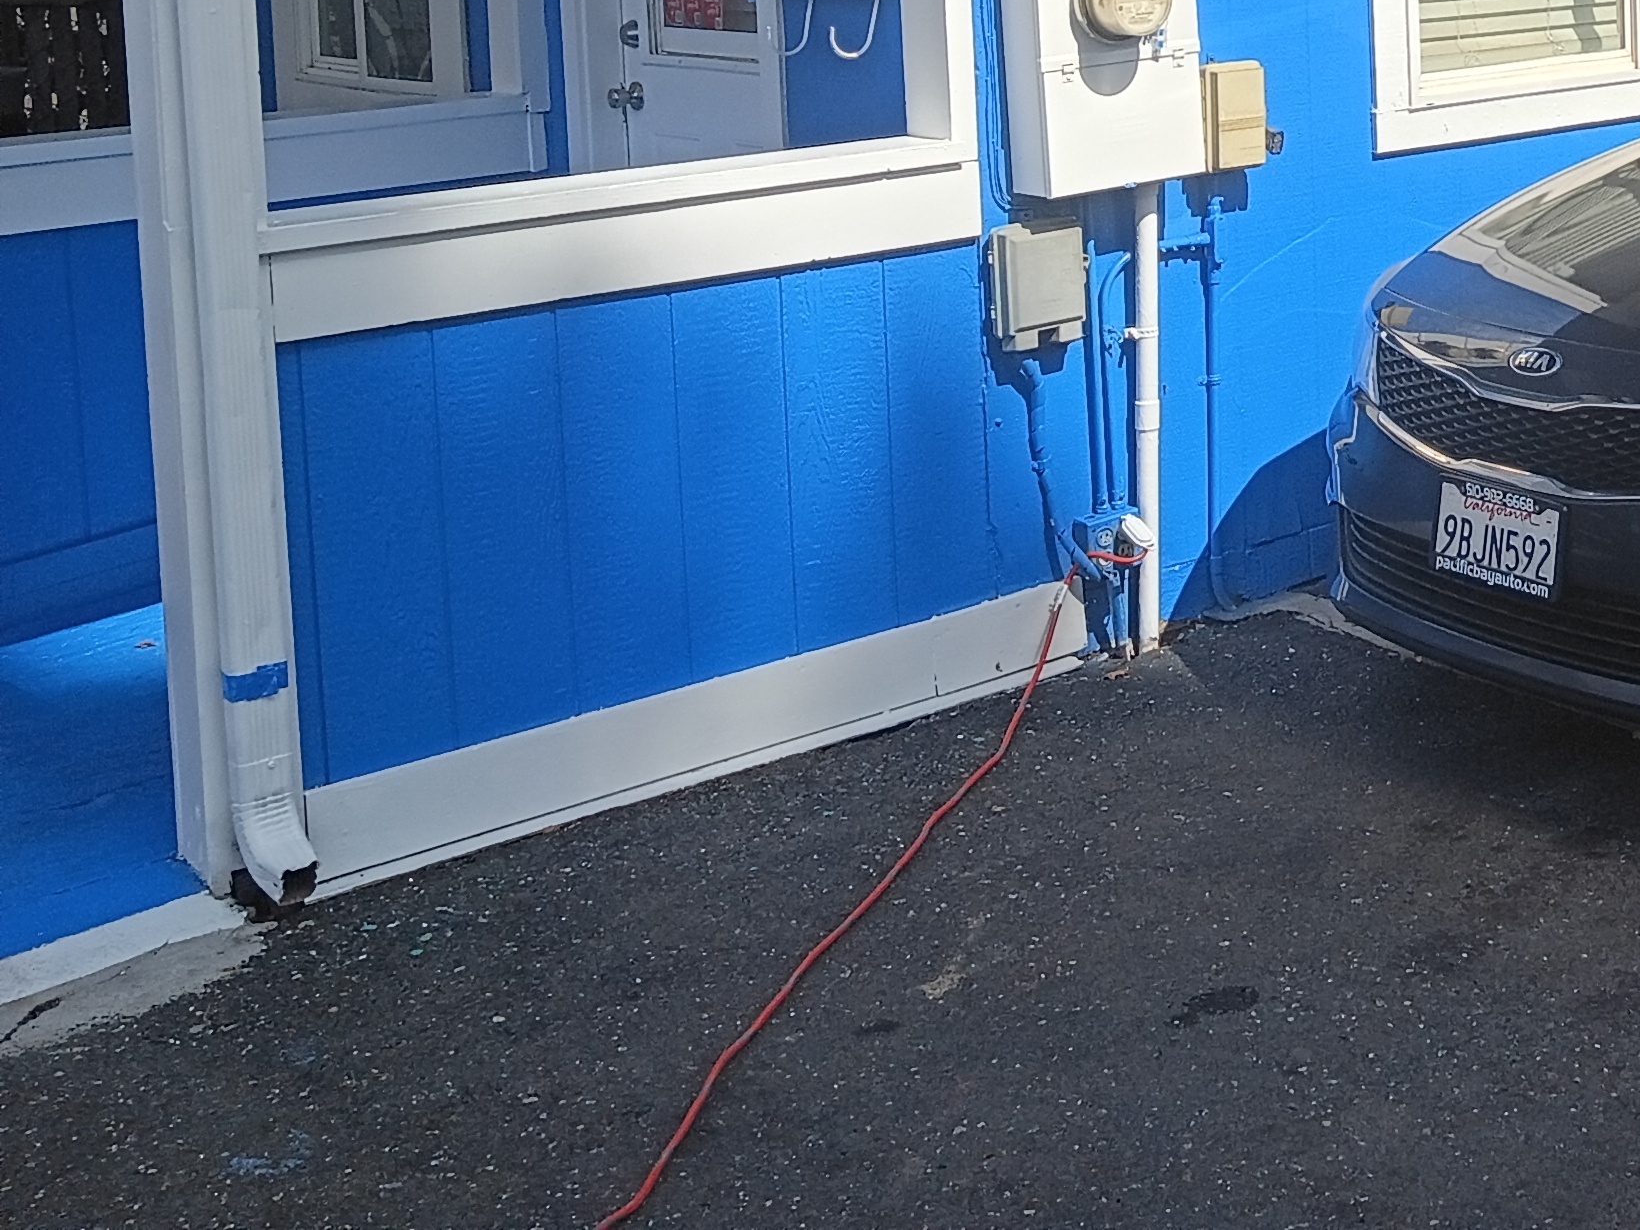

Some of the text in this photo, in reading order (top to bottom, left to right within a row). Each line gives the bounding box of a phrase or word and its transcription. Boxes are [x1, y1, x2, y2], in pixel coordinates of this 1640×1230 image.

[1514, 350, 1550, 371] KIA
[1440, 514, 1552, 583] 9BJN592
[1436, 556, 1549, 599] pacificbayauto.com
